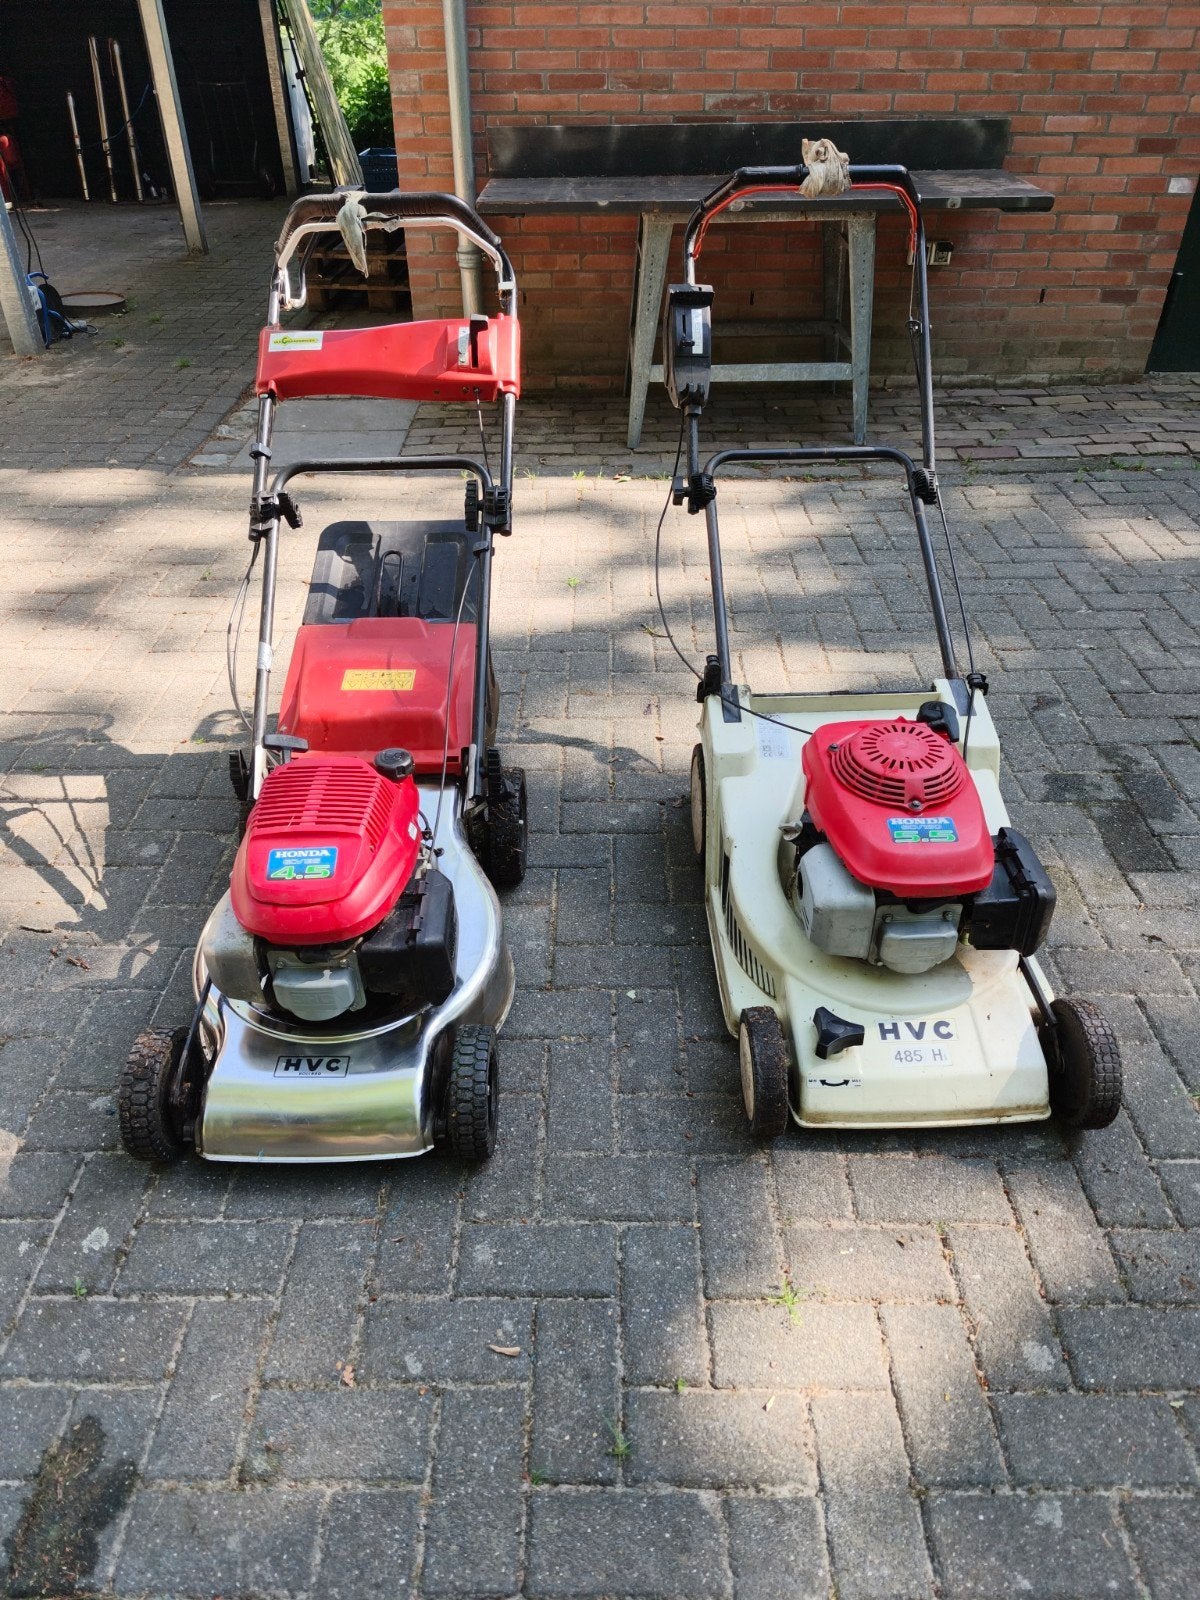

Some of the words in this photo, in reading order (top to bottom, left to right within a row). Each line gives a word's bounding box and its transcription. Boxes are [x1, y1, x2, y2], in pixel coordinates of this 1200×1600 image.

[890, 816, 951, 825] HONDA
[893, 830, 956, 843] 5.5
[275, 849, 331, 859] HONDA
[270, 865, 331, 879] 4.5
[878, 1020, 953, 1041] HVC
[894, 1049, 923, 1063] 485
[283, 1058, 342, 1072] HVC
